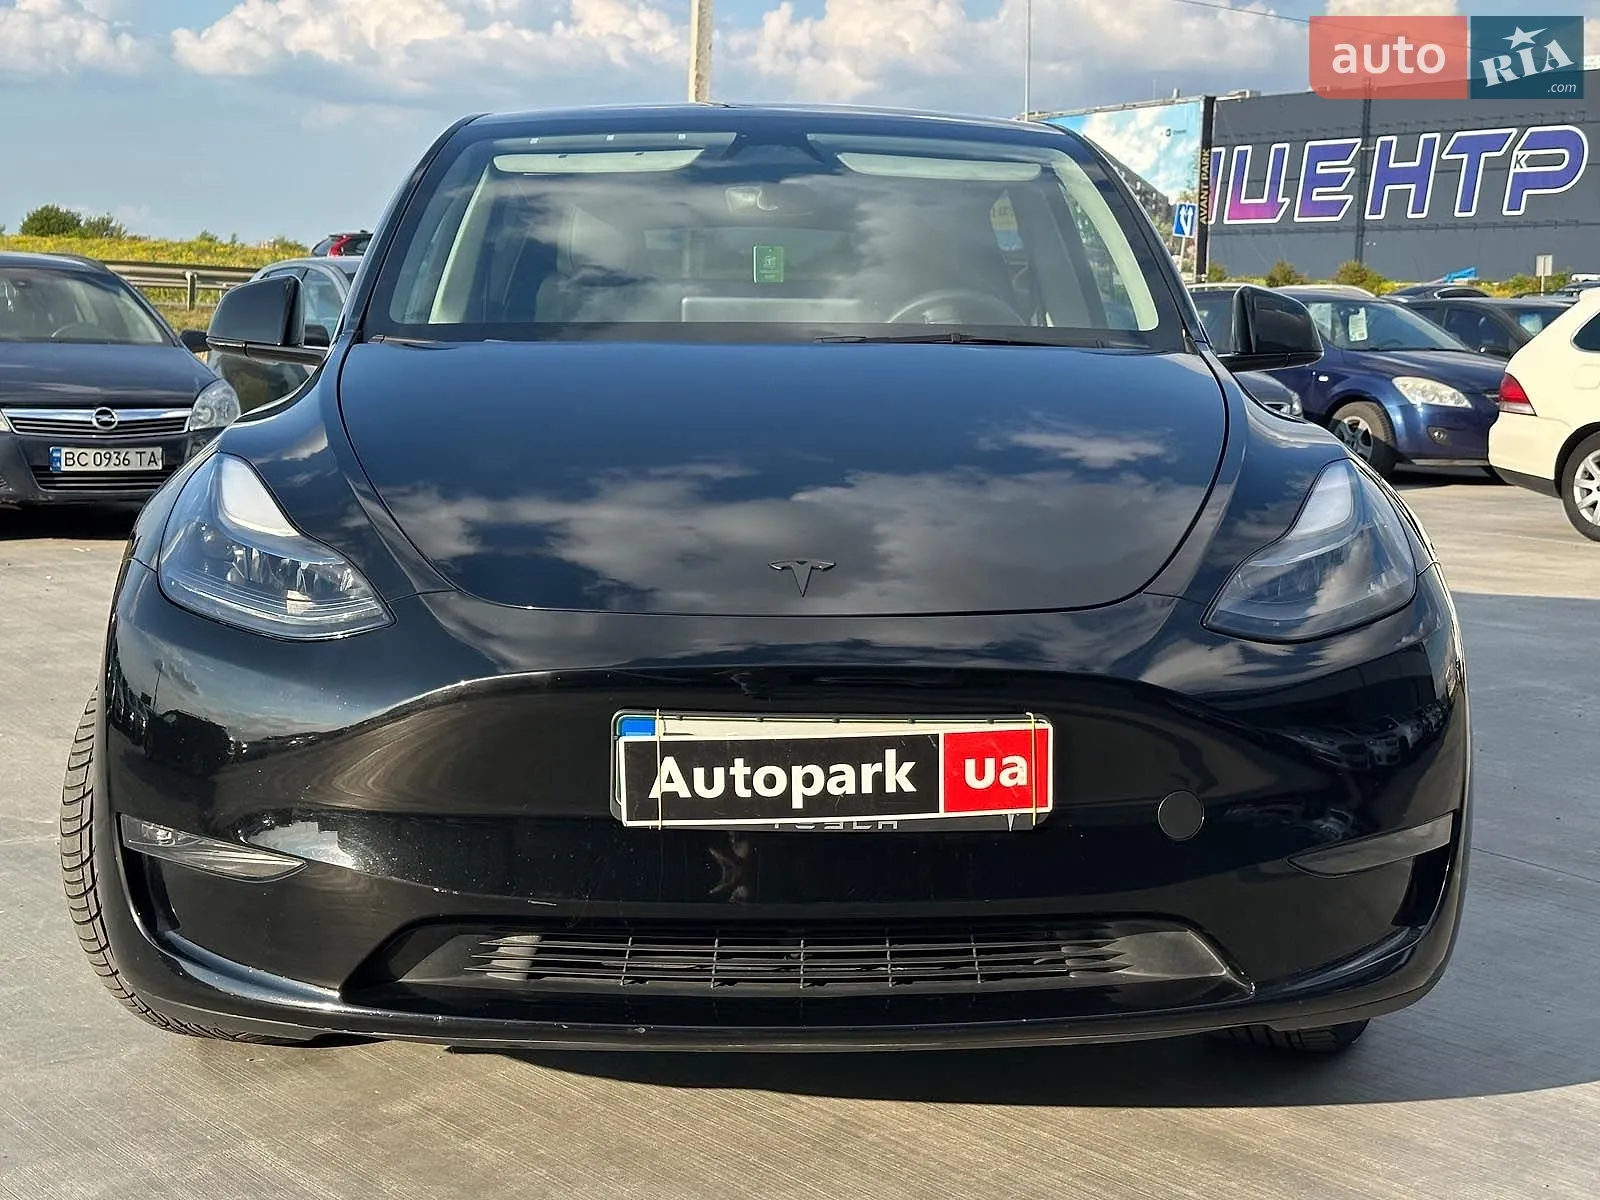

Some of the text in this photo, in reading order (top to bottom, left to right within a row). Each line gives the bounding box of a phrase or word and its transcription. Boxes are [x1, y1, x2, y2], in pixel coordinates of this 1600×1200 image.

[1199, 148, 1210, 225] AVANT PARK
[64, 450, 158, 467] BC 0936 TA
[647, 748, 1029, 810] Autopark ua
